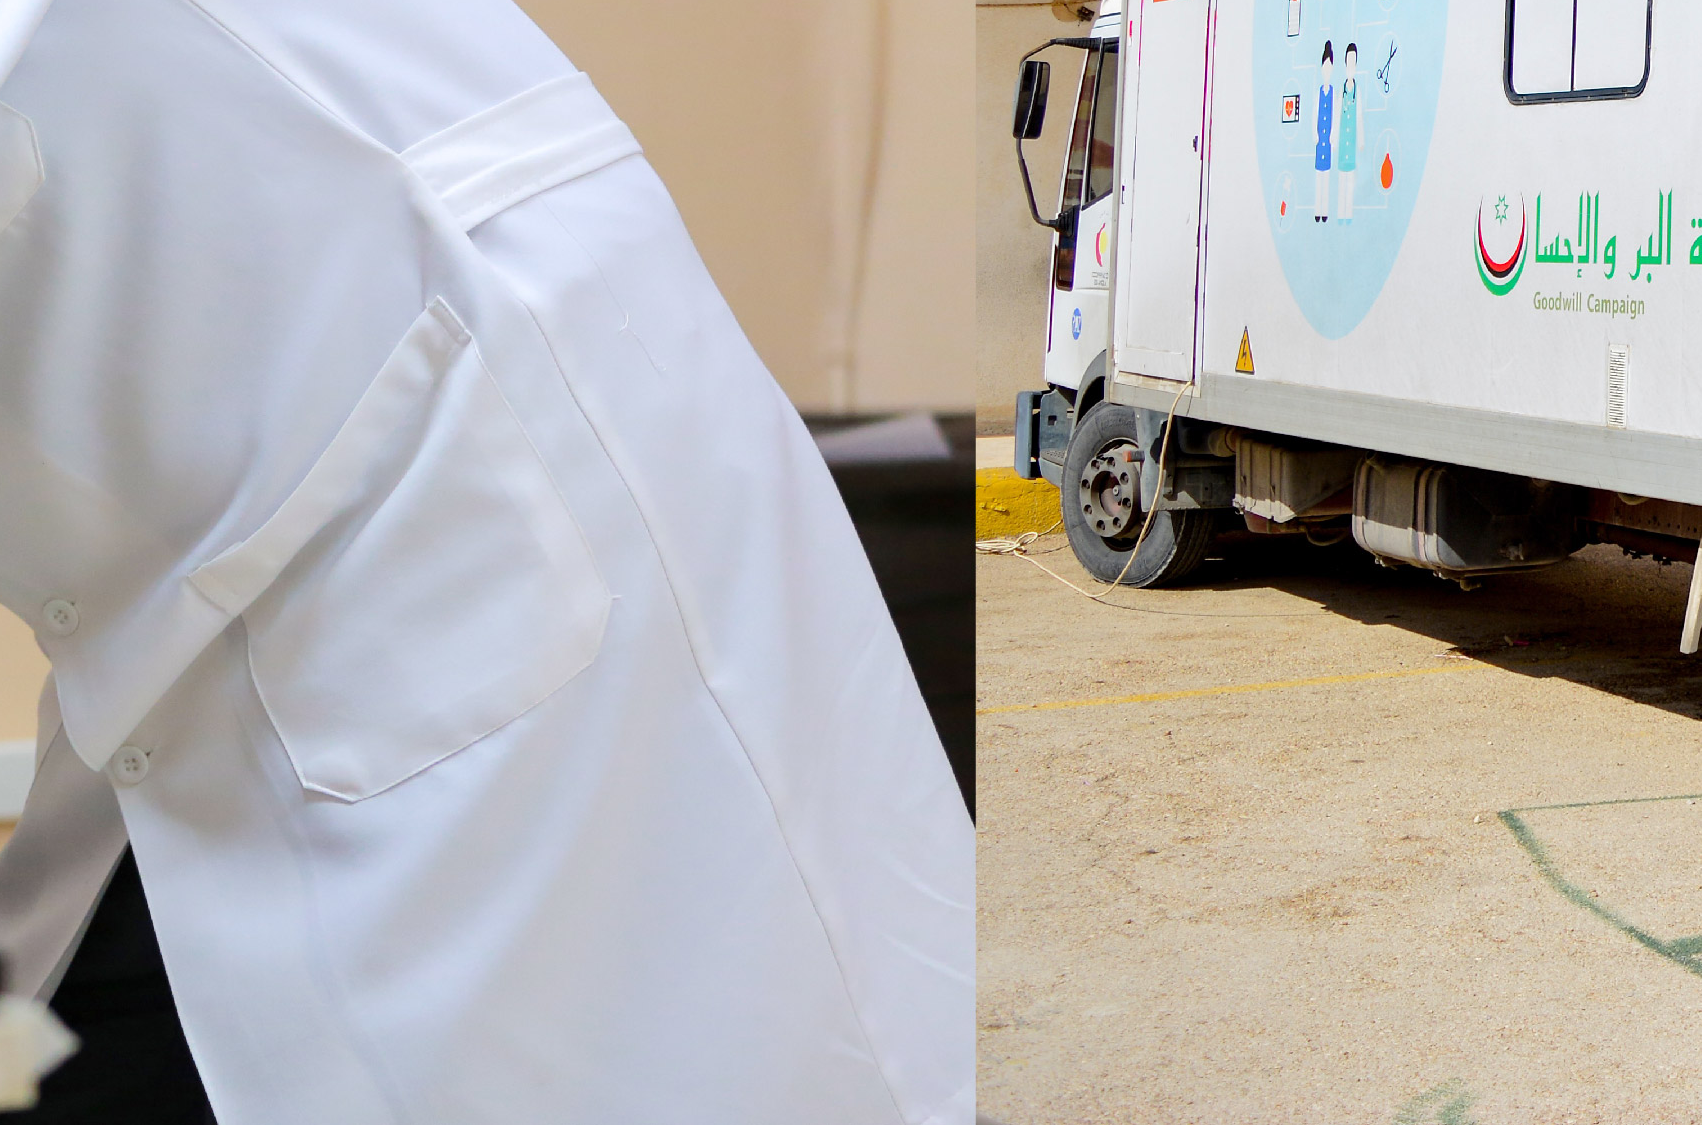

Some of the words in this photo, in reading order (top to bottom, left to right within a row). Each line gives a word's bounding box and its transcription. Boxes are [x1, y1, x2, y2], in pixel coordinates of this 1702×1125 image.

[1628, 187, 1673, 284] البر
[1533, 290, 1583, 313] Goodwill
[1587, 292, 1645, 320] Campaign
